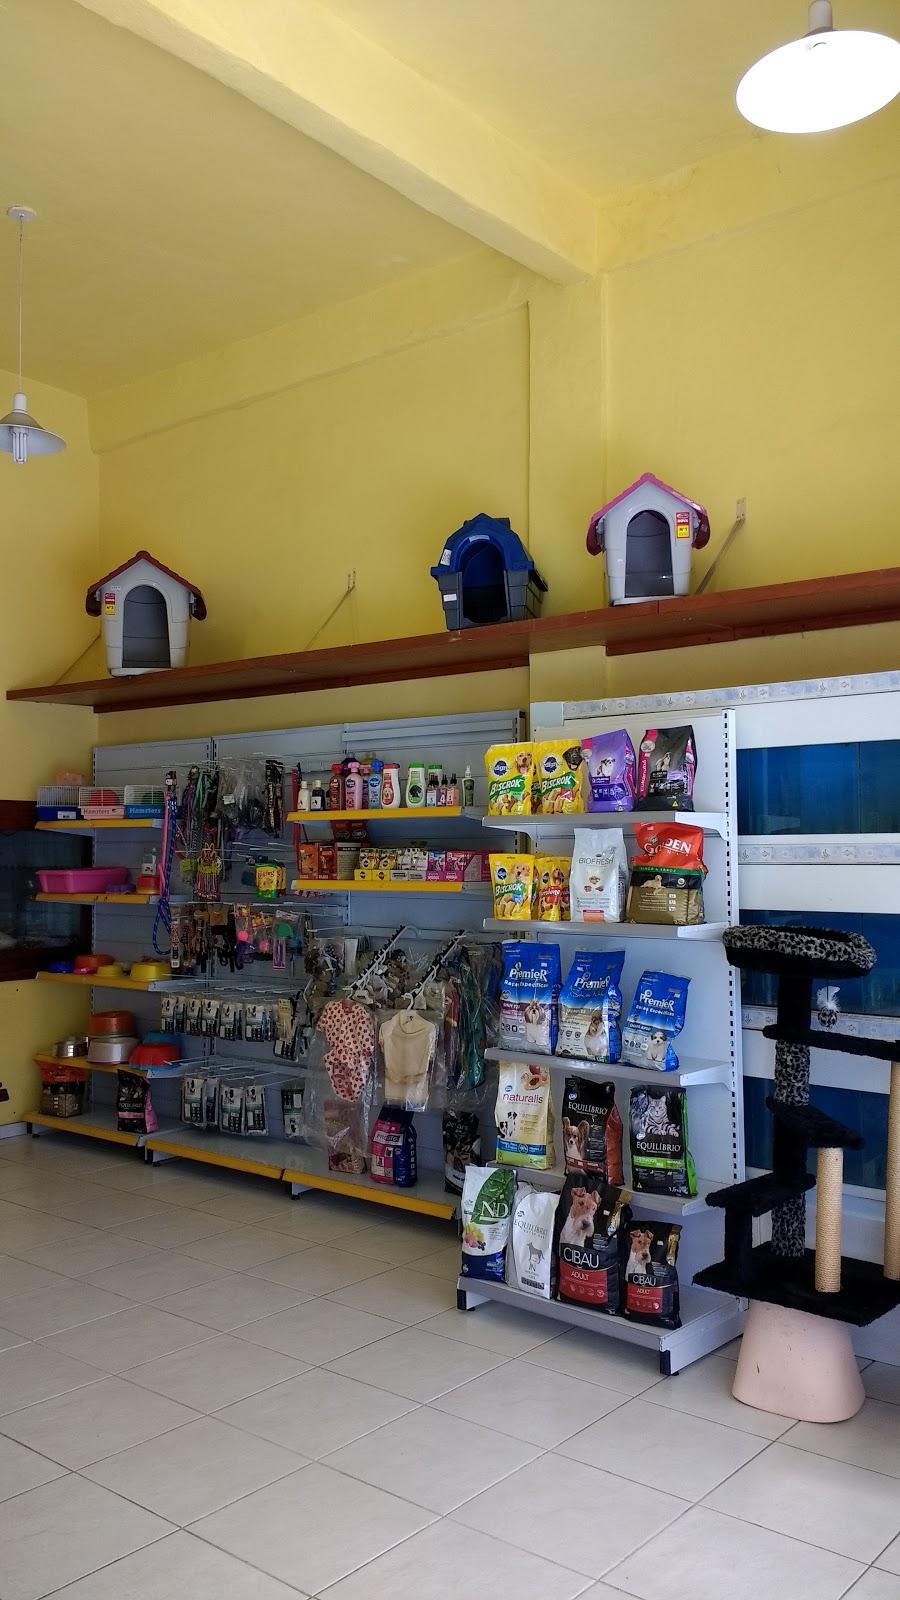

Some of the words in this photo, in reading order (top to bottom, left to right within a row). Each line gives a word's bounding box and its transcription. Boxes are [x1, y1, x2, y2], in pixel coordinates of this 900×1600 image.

[578, 857, 614, 866] BIOFRESH
[502, 1093, 544, 1104] naturalis
[563, 1247, 600, 1269] CIBAU
[570, 1270, 590, 1281] ADULT
[632, 1274, 657, 1287] CIBAU
